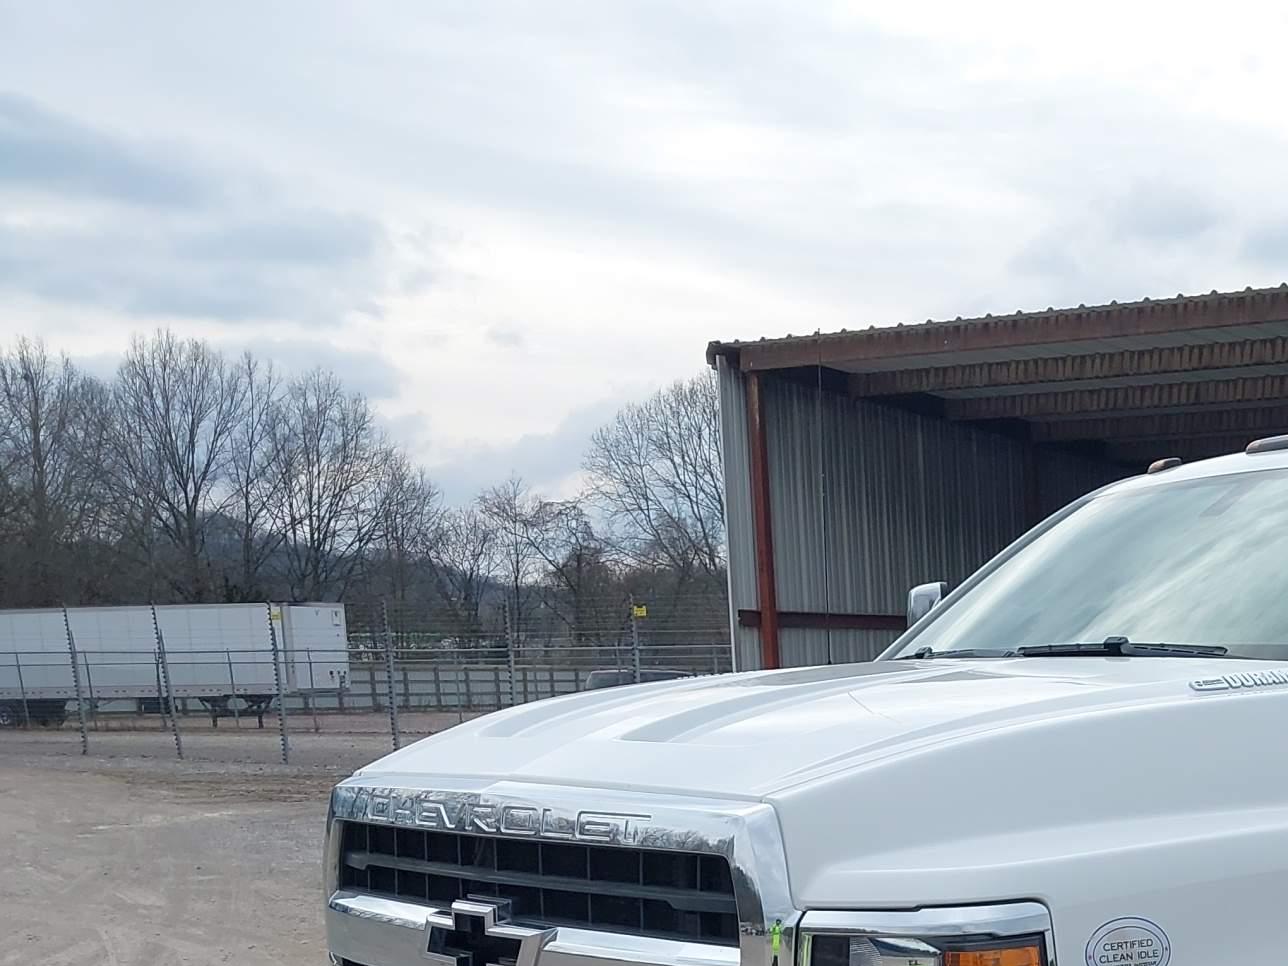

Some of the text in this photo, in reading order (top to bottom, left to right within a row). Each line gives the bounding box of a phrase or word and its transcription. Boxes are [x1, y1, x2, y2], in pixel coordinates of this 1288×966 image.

[367, 794, 652, 845] CHEVROLET
[1102, 938, 1154, 952] CERTIFIED
[1099, 952, 1133, 964] CLEAN
[1137, 949, 1160, 960] IDLE
